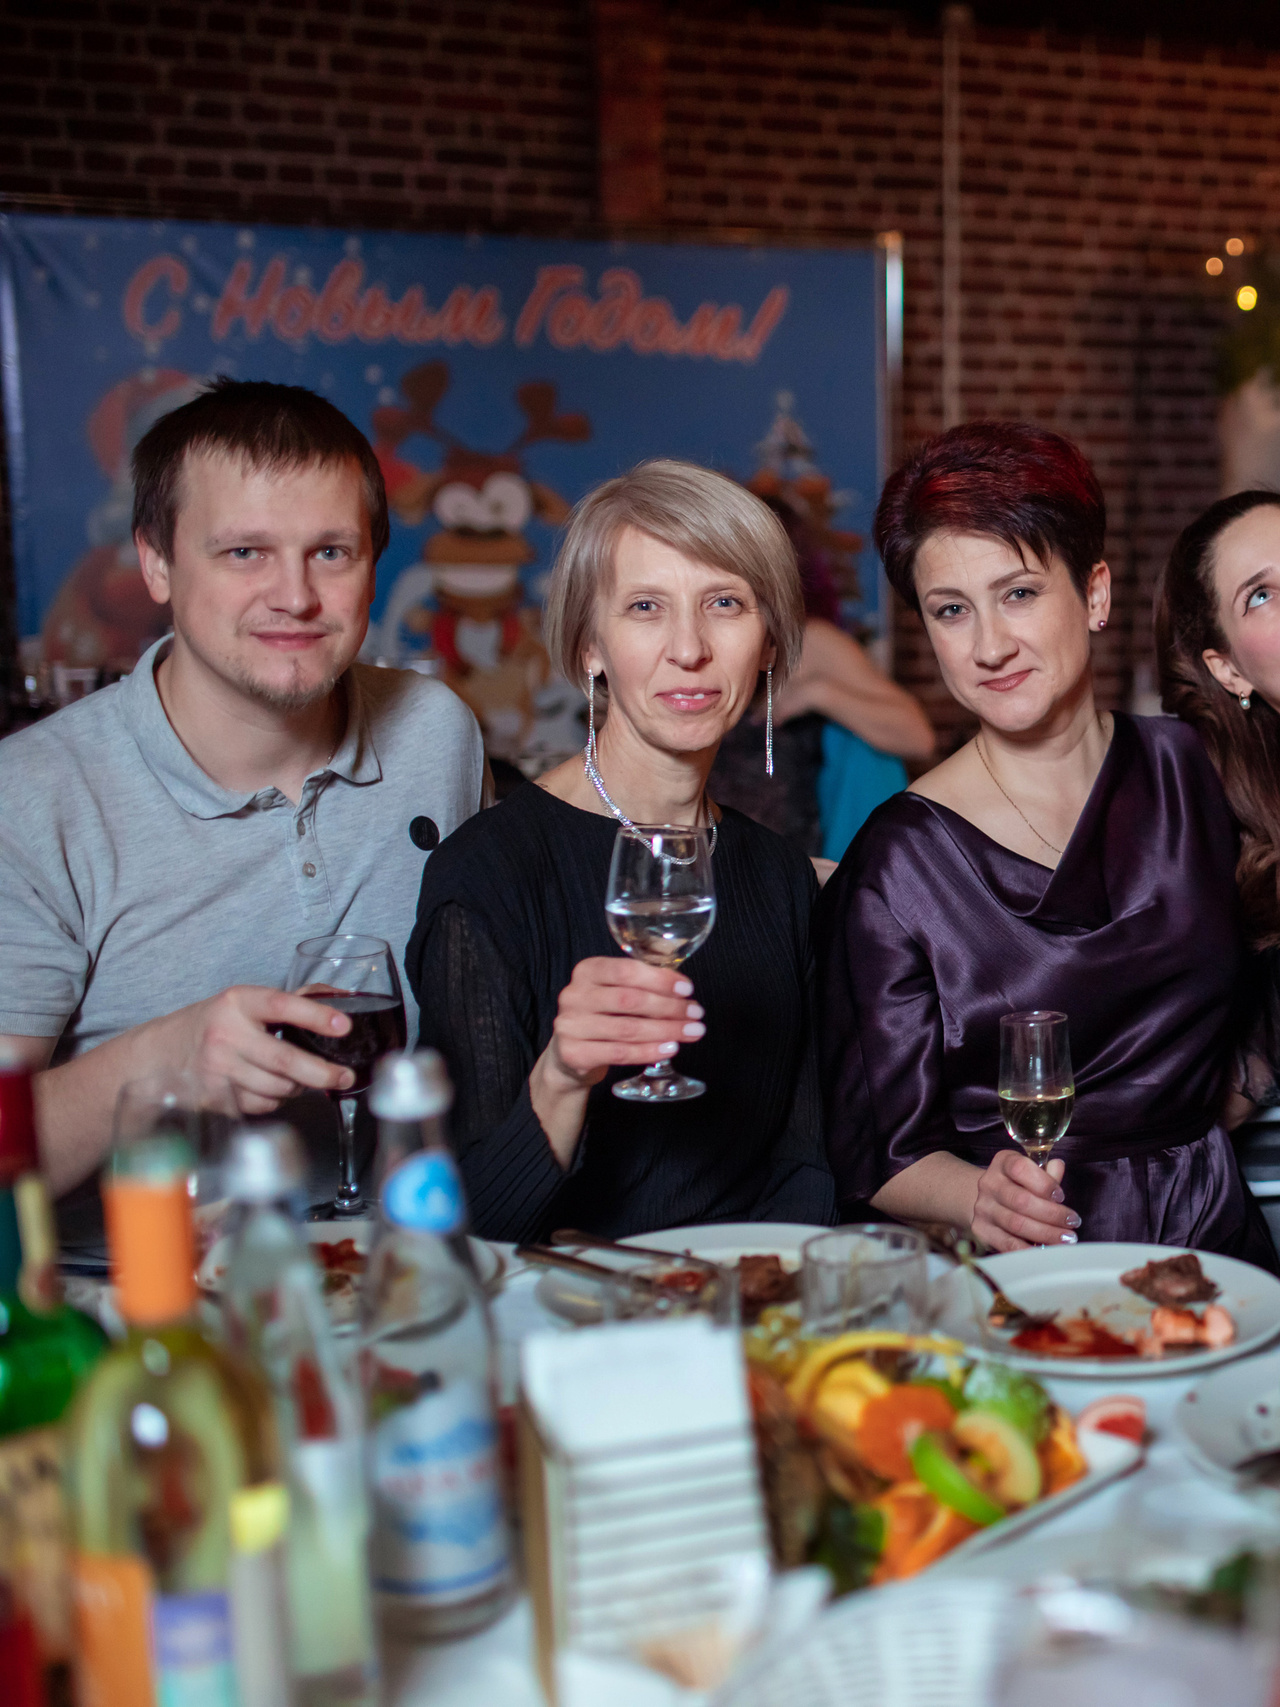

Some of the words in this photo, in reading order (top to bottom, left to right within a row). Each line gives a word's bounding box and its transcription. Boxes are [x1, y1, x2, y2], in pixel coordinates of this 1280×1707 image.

[124, 253, 189, 340] С
[211, 254, 504, 345] Новым
[515, 264, 790, 363] Годом!
